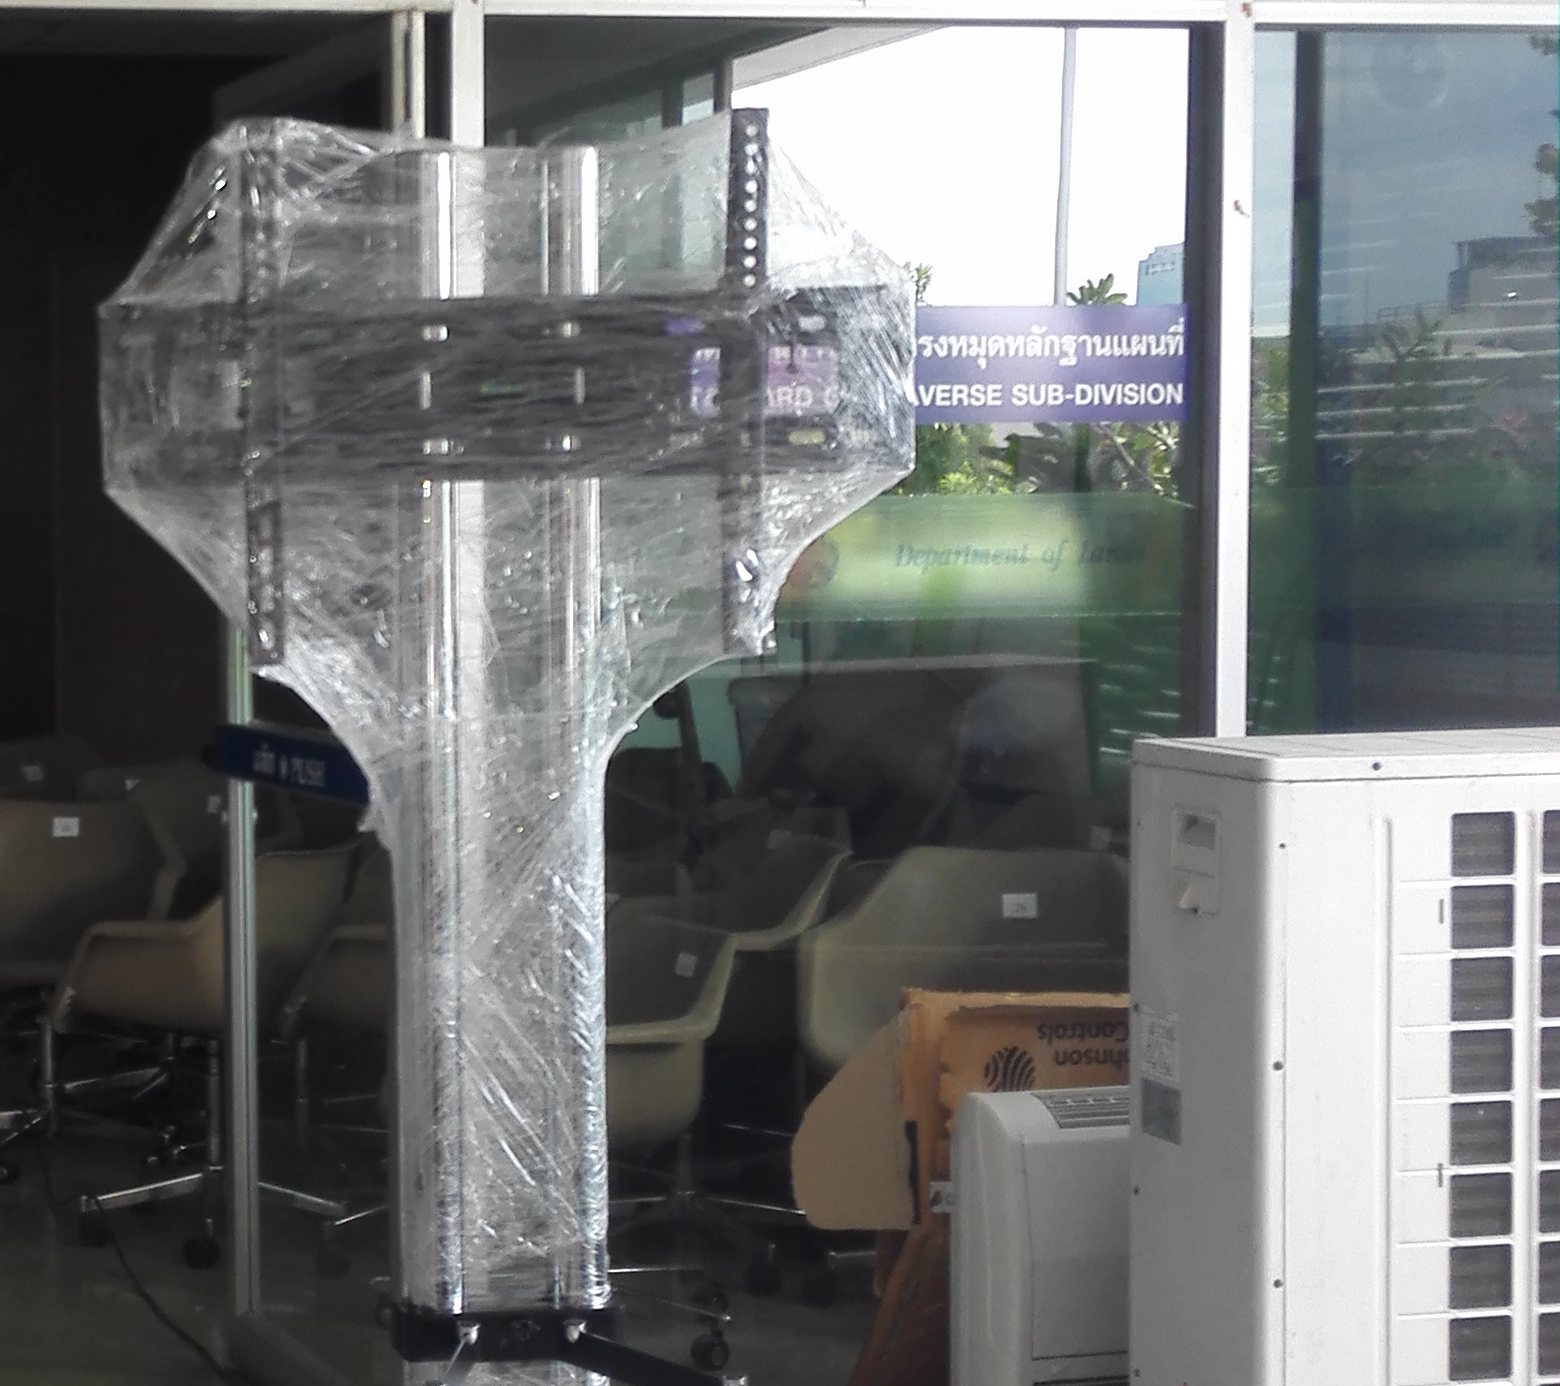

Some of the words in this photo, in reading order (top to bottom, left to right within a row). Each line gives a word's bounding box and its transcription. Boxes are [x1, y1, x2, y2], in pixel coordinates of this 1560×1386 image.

[916, 317, 1184, 370] รงหมุดหลักฐานแผนที่
[1011, 382, 1184, 406] SUB-DIVISION
